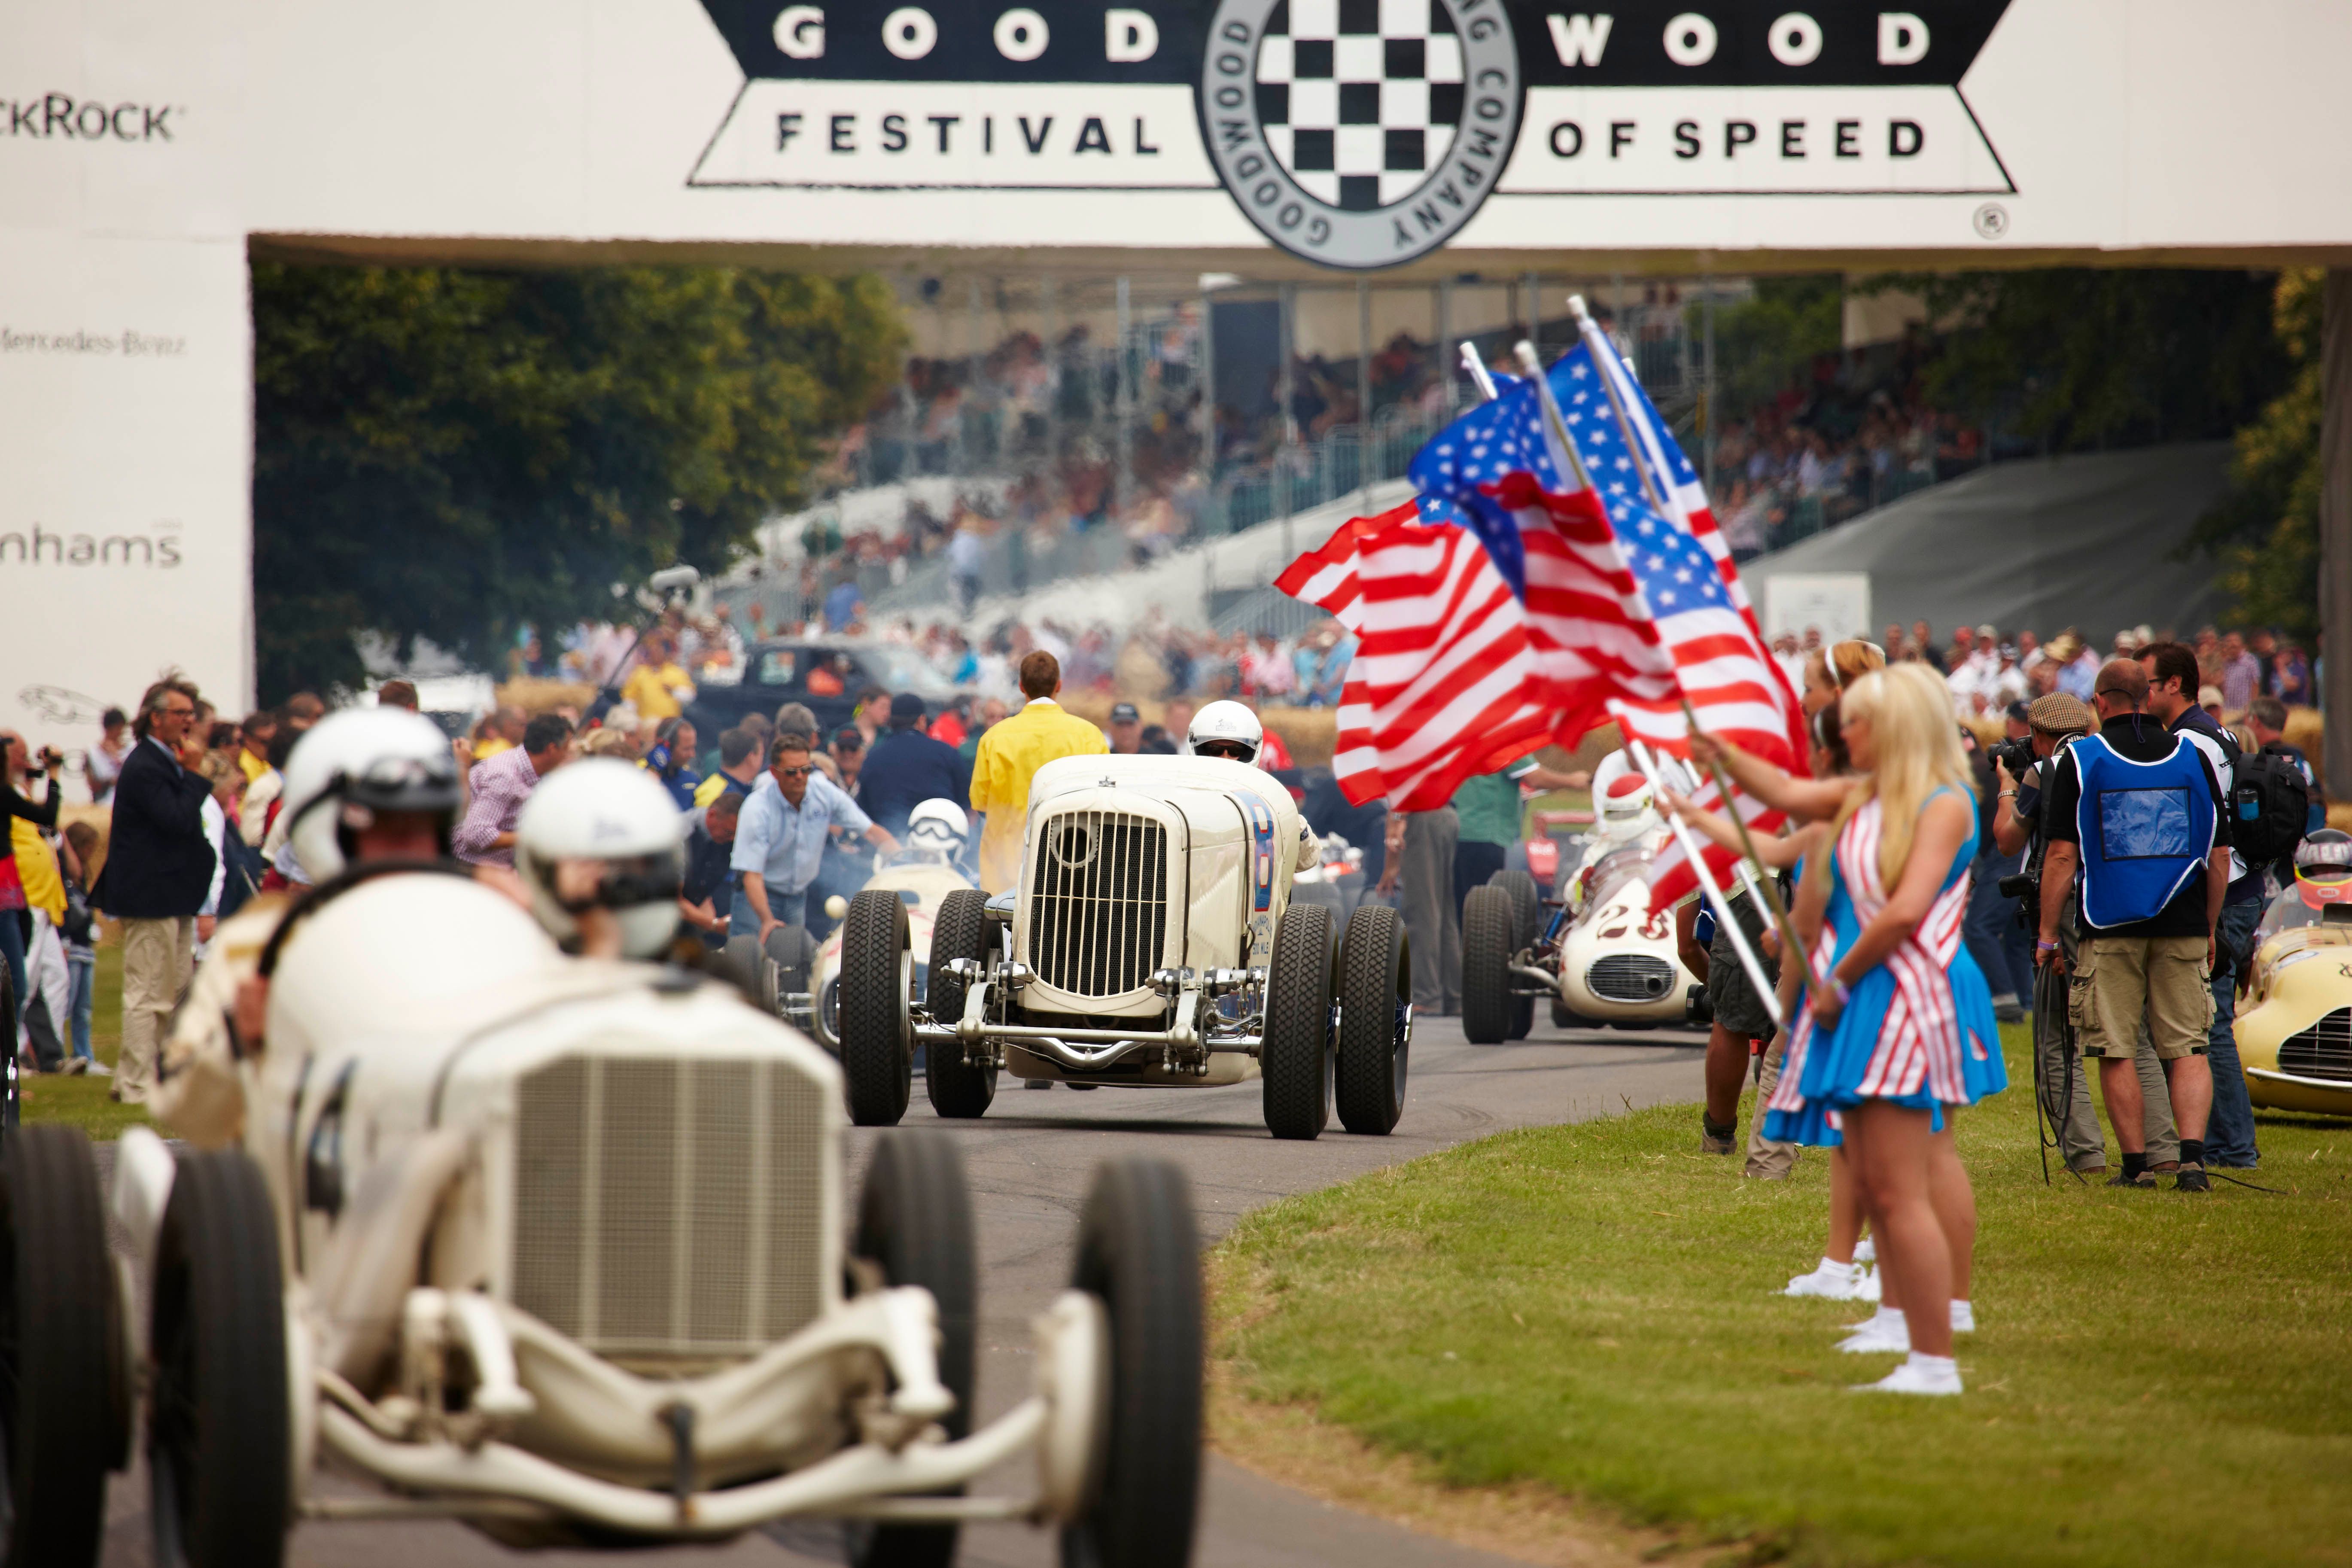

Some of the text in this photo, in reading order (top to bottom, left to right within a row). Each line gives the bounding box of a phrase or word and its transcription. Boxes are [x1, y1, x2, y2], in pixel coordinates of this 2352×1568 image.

[773, 6, 1931, 67] GOOD WOOD
[778, 113, 1925, 159] FESTIVAL OF SPEED
[1215, 20, 1330, 246] GOODWOOD
[1394, 68, 1507, 248] COMPANY
[1232, 788, 1274, 912] 8
